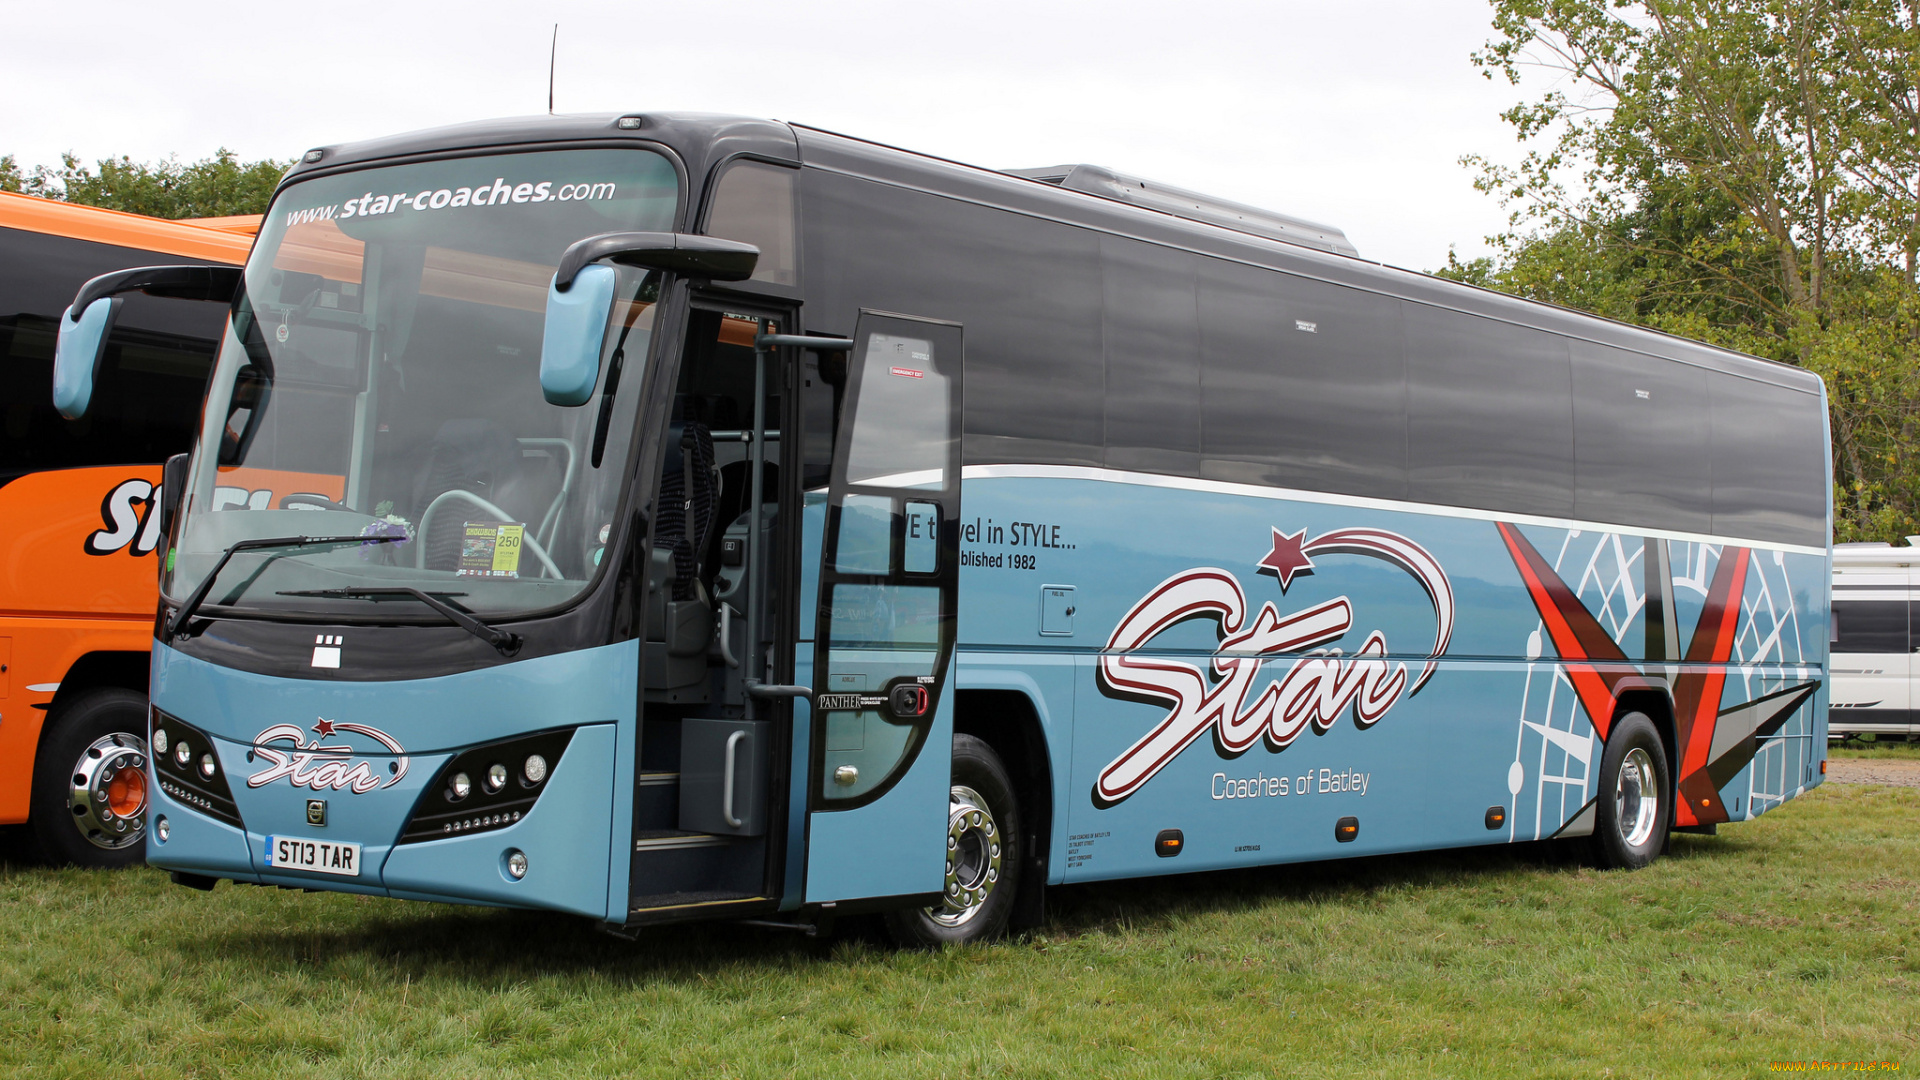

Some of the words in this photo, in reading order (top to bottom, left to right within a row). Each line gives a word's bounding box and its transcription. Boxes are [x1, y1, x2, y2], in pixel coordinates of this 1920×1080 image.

[286, 178, 616, 227] www.star-coaches.com
[498, 535, 520, 547] 250
[905, 513, 921, 539] E
[987, 518, 1004, 544] in
[1010, 521, 1076, 550] STYLE...
[1007, 553, 1036, 570] 1982
[820, 695, 860, 708] PANTHER
[1091, 566, 1408, 810] Star
[247, 723, 382, 794] Star
[1212, 772, 1289, 800] Coaches
[1296, 769, 1314, 795] of
[1318, 766, 1370, 796] Batley
[279, 840, 315, 865] ST13
[321, 845, 353, 870] TAR
